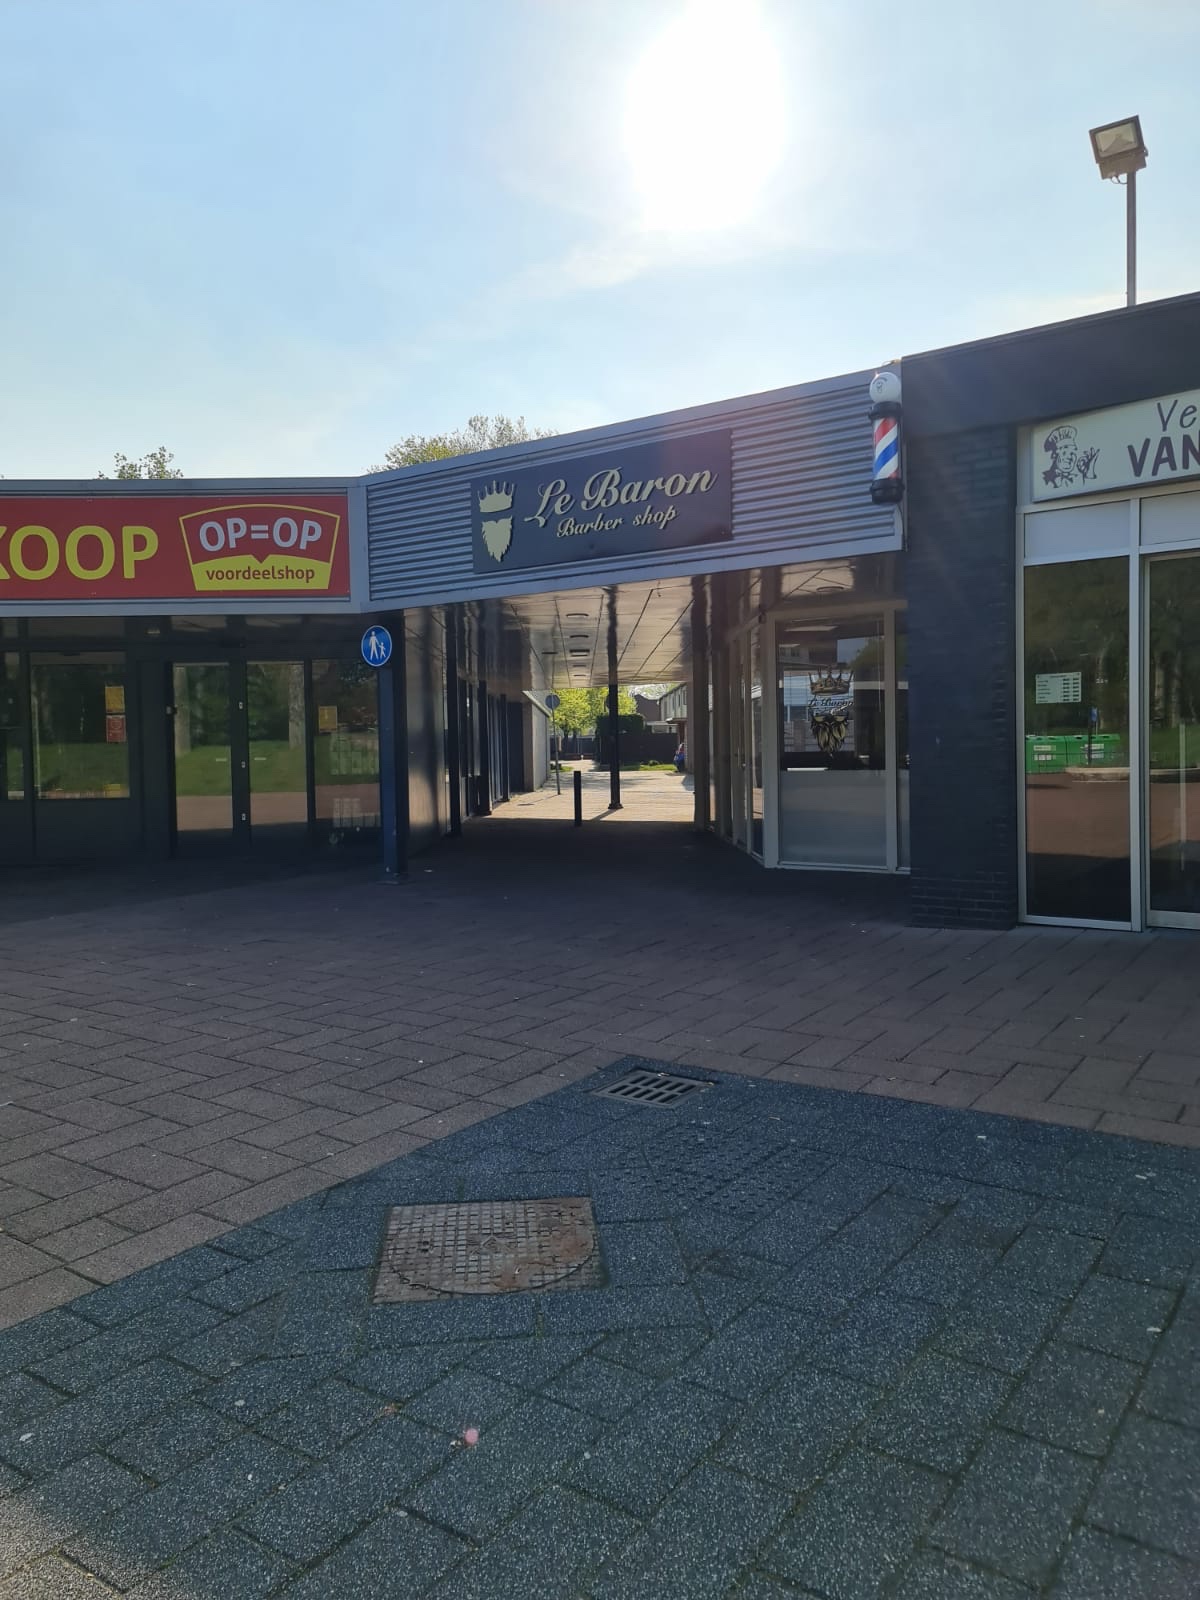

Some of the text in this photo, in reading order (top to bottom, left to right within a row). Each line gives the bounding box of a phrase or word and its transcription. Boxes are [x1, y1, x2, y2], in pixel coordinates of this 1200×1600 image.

[1127, 431, 1200, 478] VAN
[523, 466, 718, 528] Le Baron
[199, 517, 322, 551] OP=OP
[556, 504, 678, 538] Barber shop
[0, 525, 159, 580] OOP
[206, 565, 315, 583] voordeelshop
